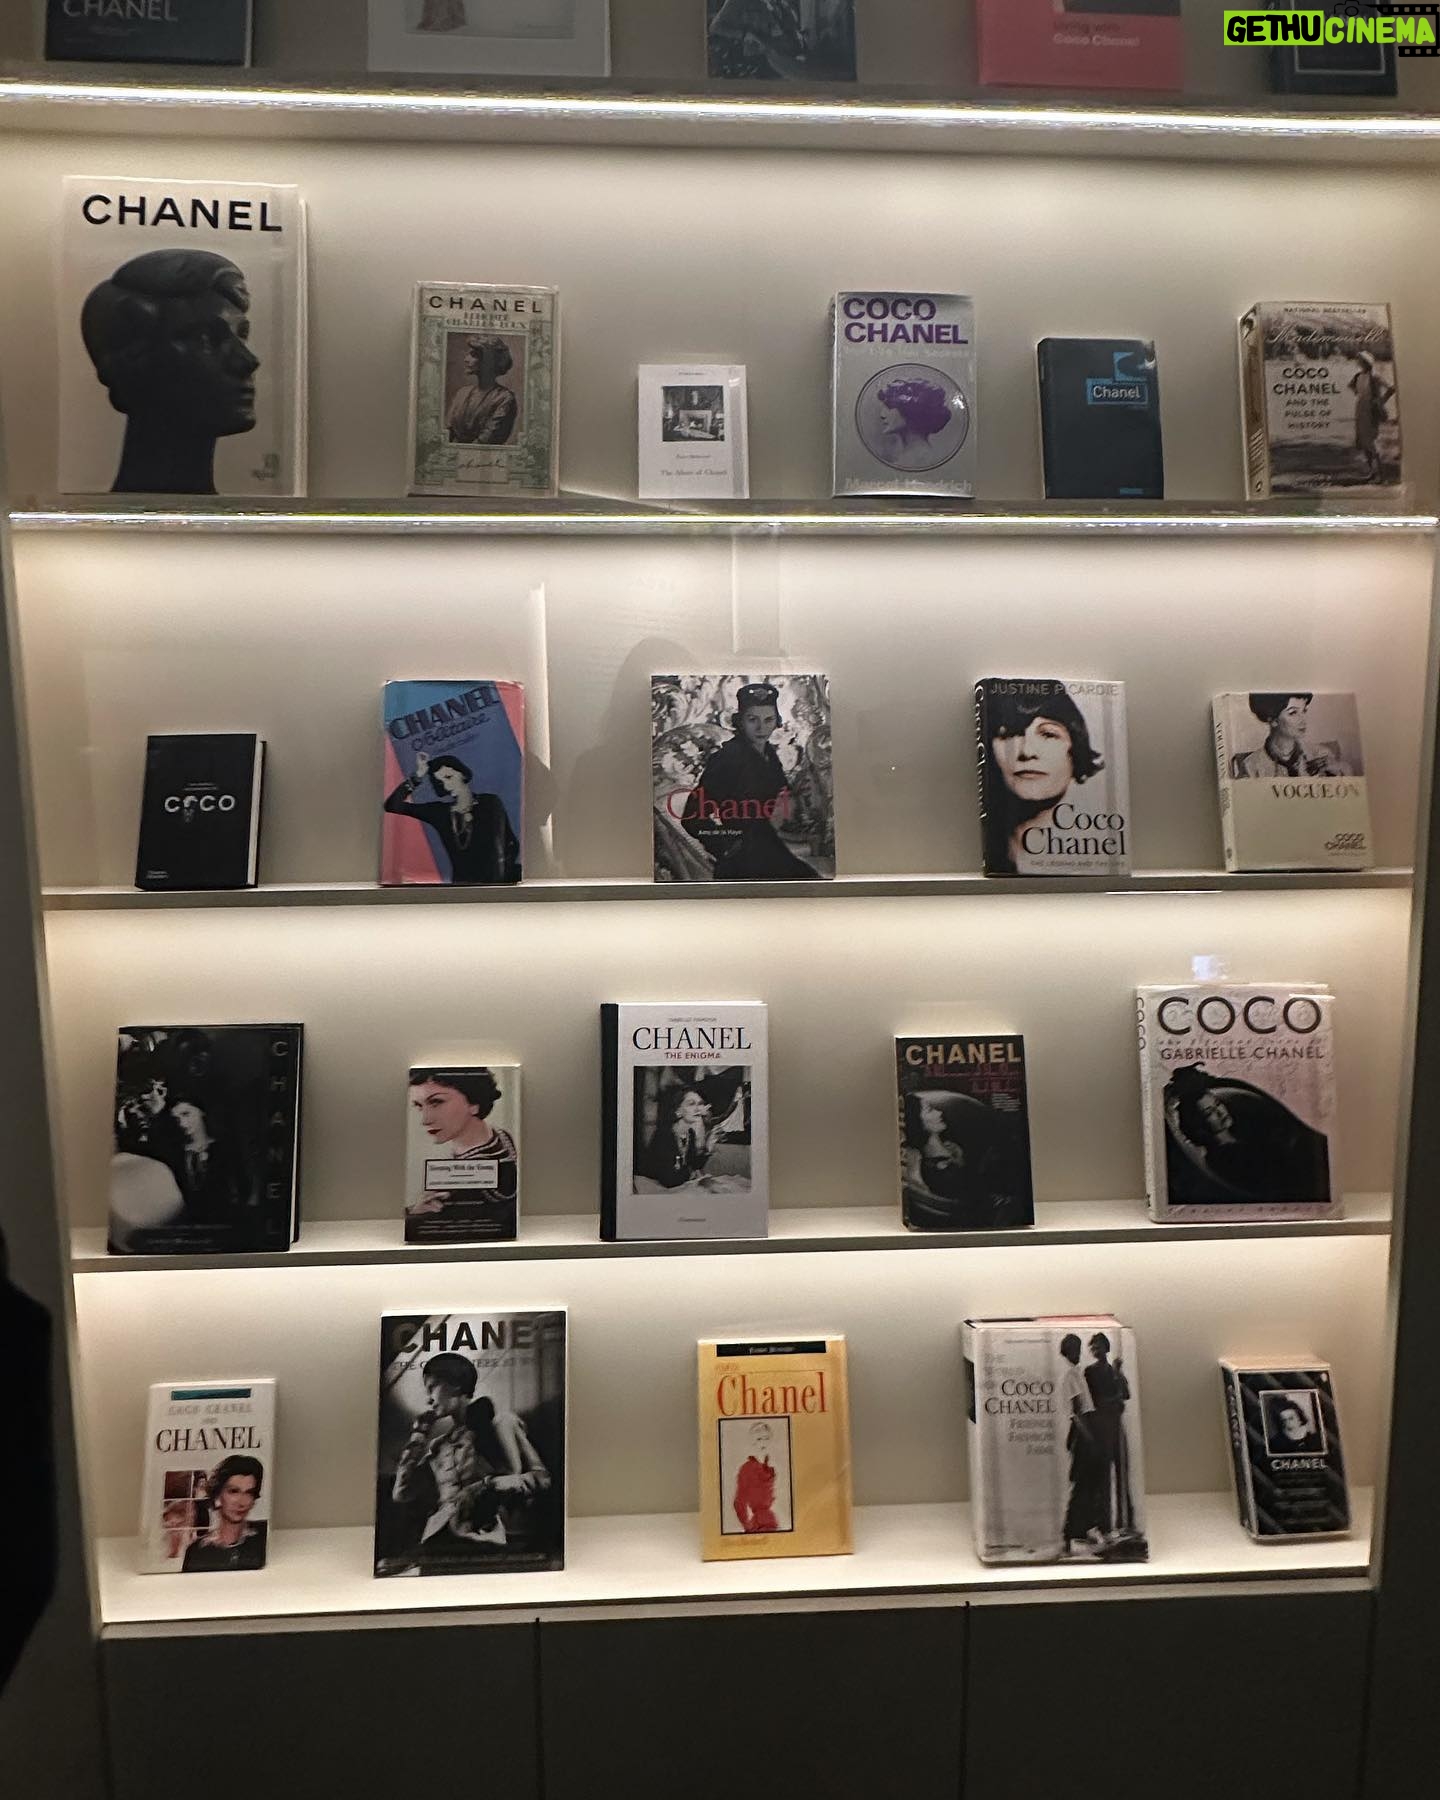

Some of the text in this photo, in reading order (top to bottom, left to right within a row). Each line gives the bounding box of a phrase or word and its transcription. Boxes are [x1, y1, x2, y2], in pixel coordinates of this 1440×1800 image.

[63, 0, 178, 21] CHANEL
[82, 194, 283, 232] CHANEL
[429, 296, 543, 313] CHANEL
[843, 298, 937, 320] COCO
[844, 322, 969, 344] CHANEL
[1282, 367, 1329, 379] COCO
[1093, 385, 1140, 399] Chanel
[1273, 383, 1341, 395] CHANEL
[991, 683, 1119, 696] JUSTINE PCARDIE
[1272, 784, 1334, 799] VOGUE
[667, 786, 793, 820] Chanel
[1052, 803, 1124, 831] Coco
[1022, 826, 1126, 855] Chanel
[1158, 996, 1322, 1035] COCO
[632, 1027, 751, 1050] CHANEL
[665, 1052, 721, 1060] THE ENIGMA
[905, 1043, 1022, 1065] CHANEL
[1160, 1046, 1325, 1060] GABRIELLE CHANEL
[391, 1321, 557, 1353] CHANE
[717, 1372, 829, 1416] Chanel
[985, 1397, 1057, 1415] CHANEL
[156, 1426, 262, 1453] CHANEL
[1270, 1458, 1328, 1471] CHANEL
